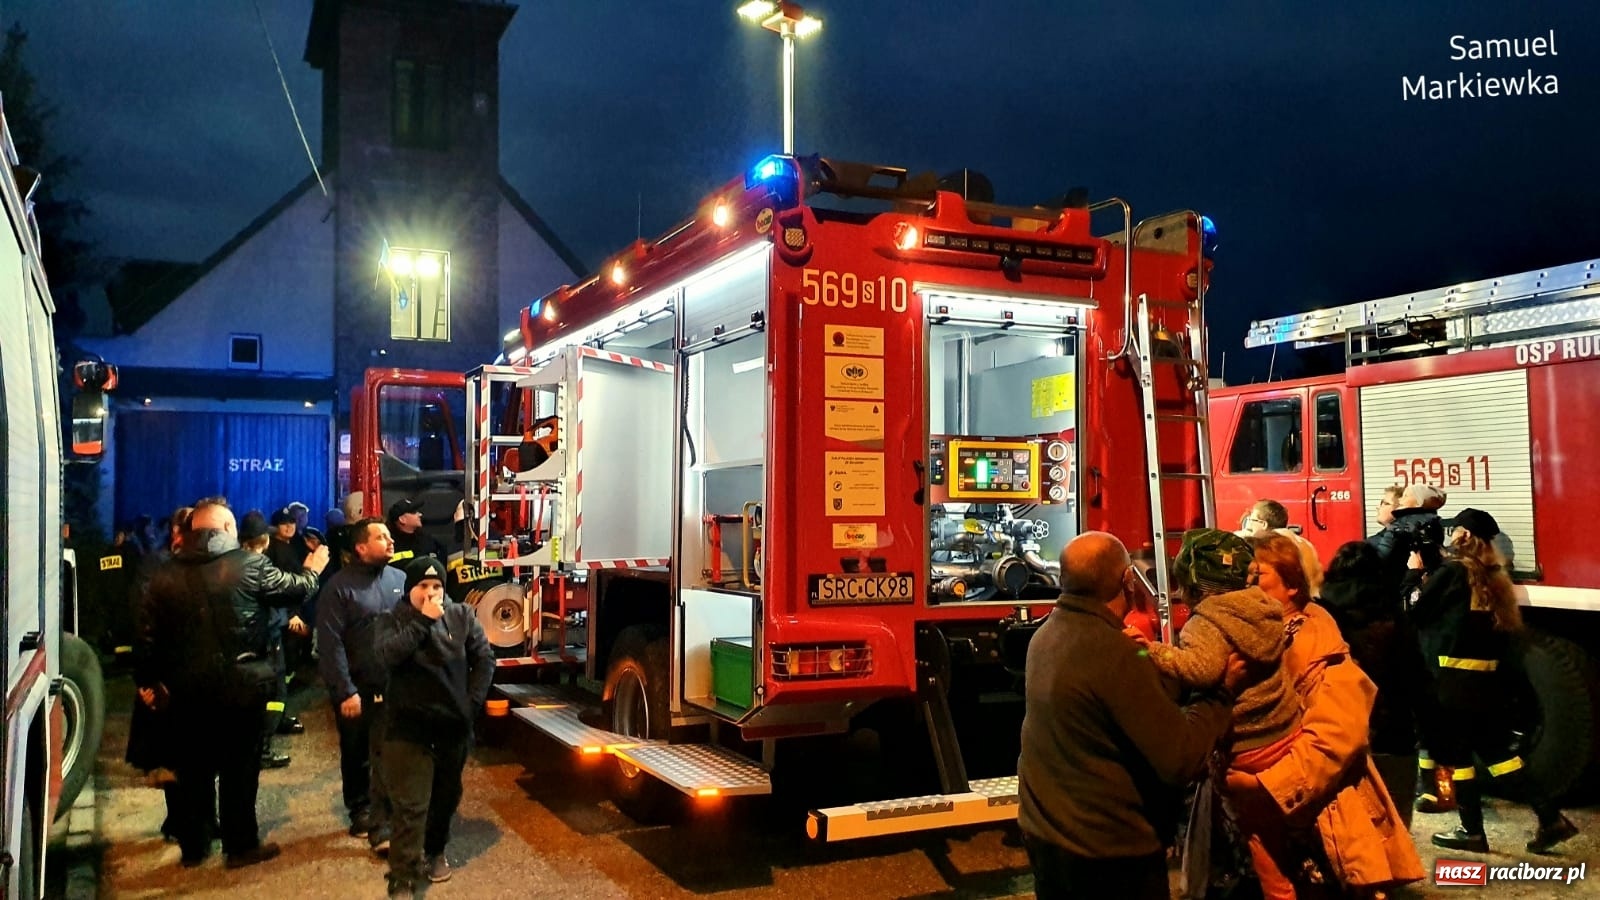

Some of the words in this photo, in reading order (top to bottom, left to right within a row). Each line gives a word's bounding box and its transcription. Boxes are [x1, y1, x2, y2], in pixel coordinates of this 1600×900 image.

[1516, 341, 1556, 365] OSP
[1330, 491, 1350, 501] 266
[823, 578, 858, 599] SRC
[864, 576, 908, 598] CK98
